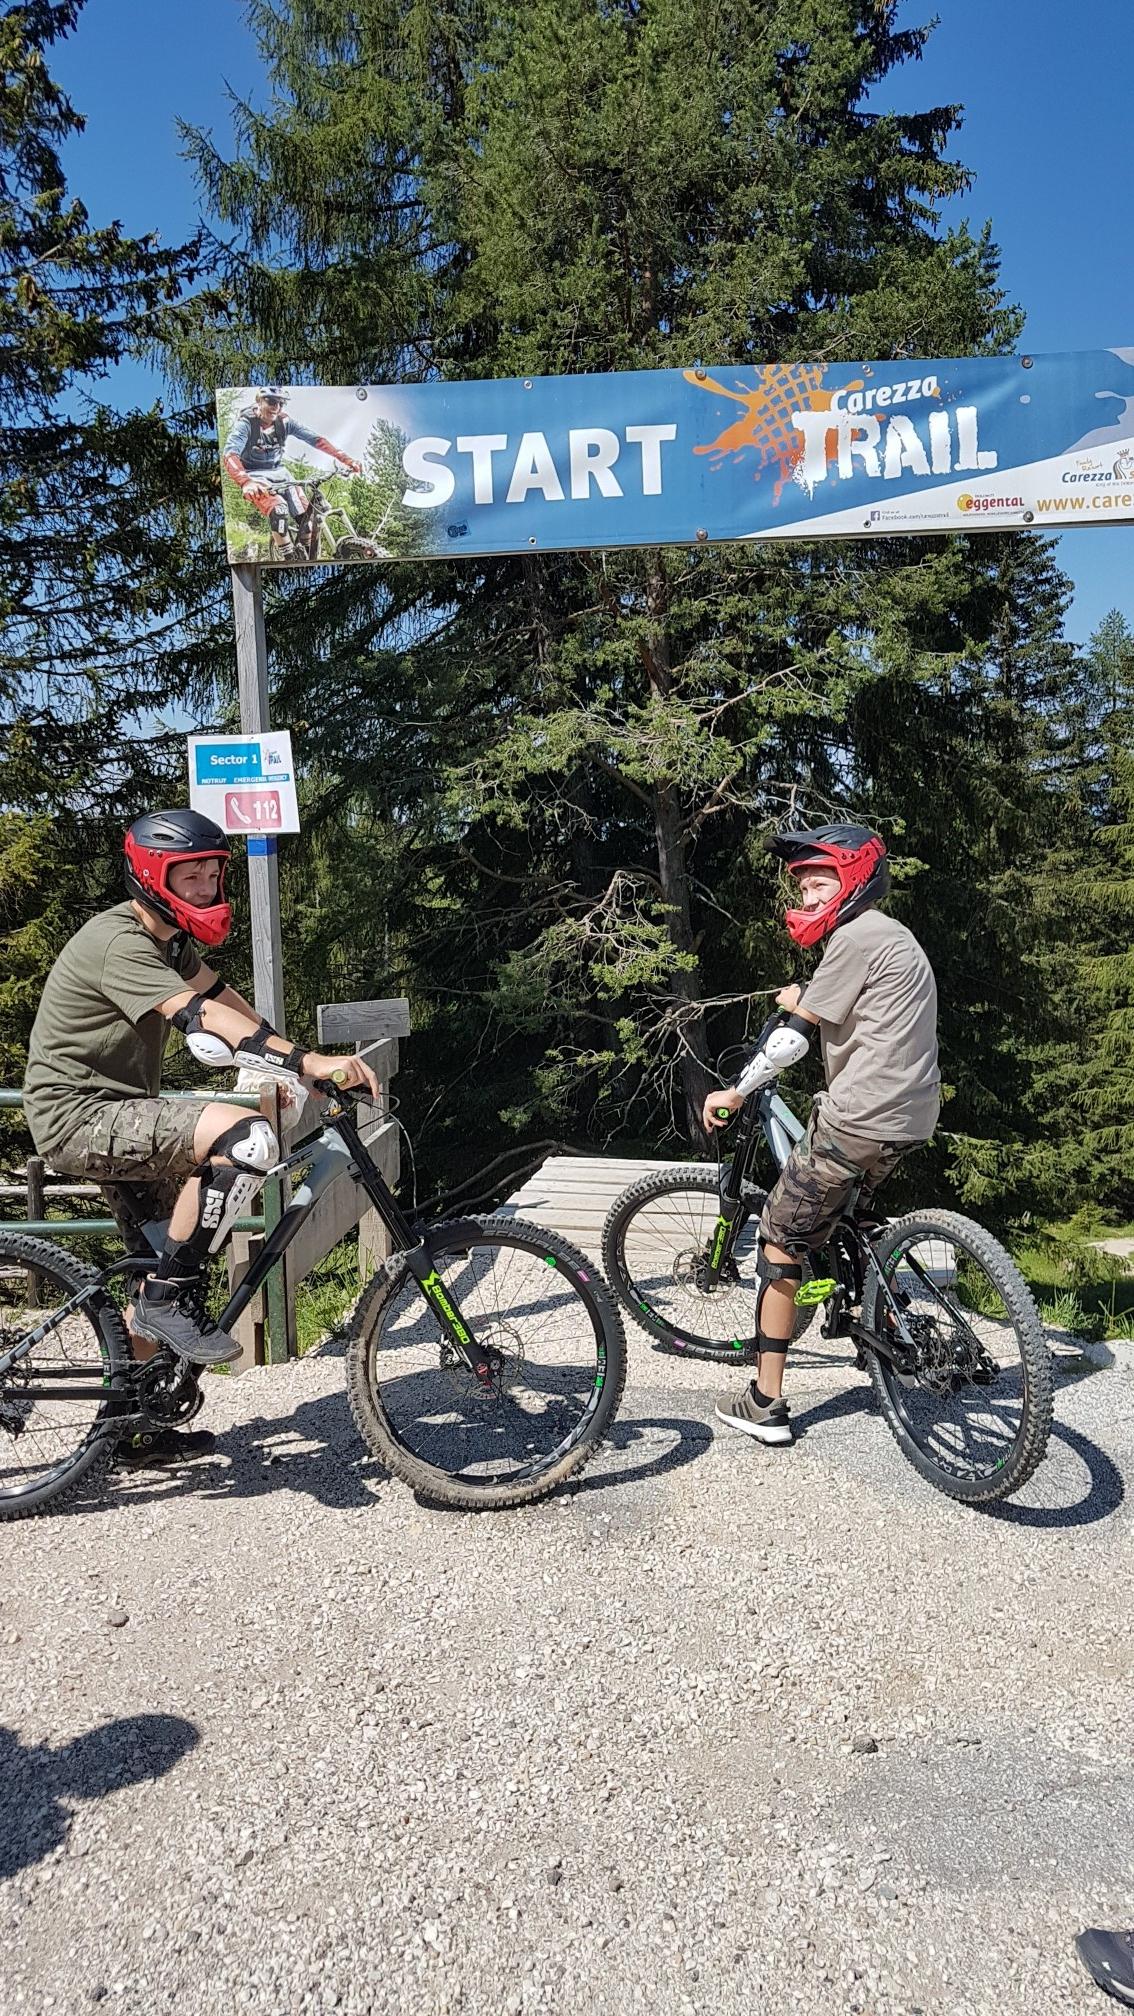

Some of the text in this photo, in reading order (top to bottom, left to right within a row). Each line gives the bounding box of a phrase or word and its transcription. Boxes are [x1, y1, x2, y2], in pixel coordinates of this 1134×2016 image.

[830, 375, 938, 414] Carezza
[791, 406, 998, 486] TRAIL
[401, 423, 678, 509] START
[1062, 471, 1112, 484] Carezza
[965, 497, 1025, 511] eggental
[1036, 493, 1134, 512] www.care
[210, 754, 248, 766] Sector
[251, 754, 258, 764] 1
[253, 800, 278, 820] 112
